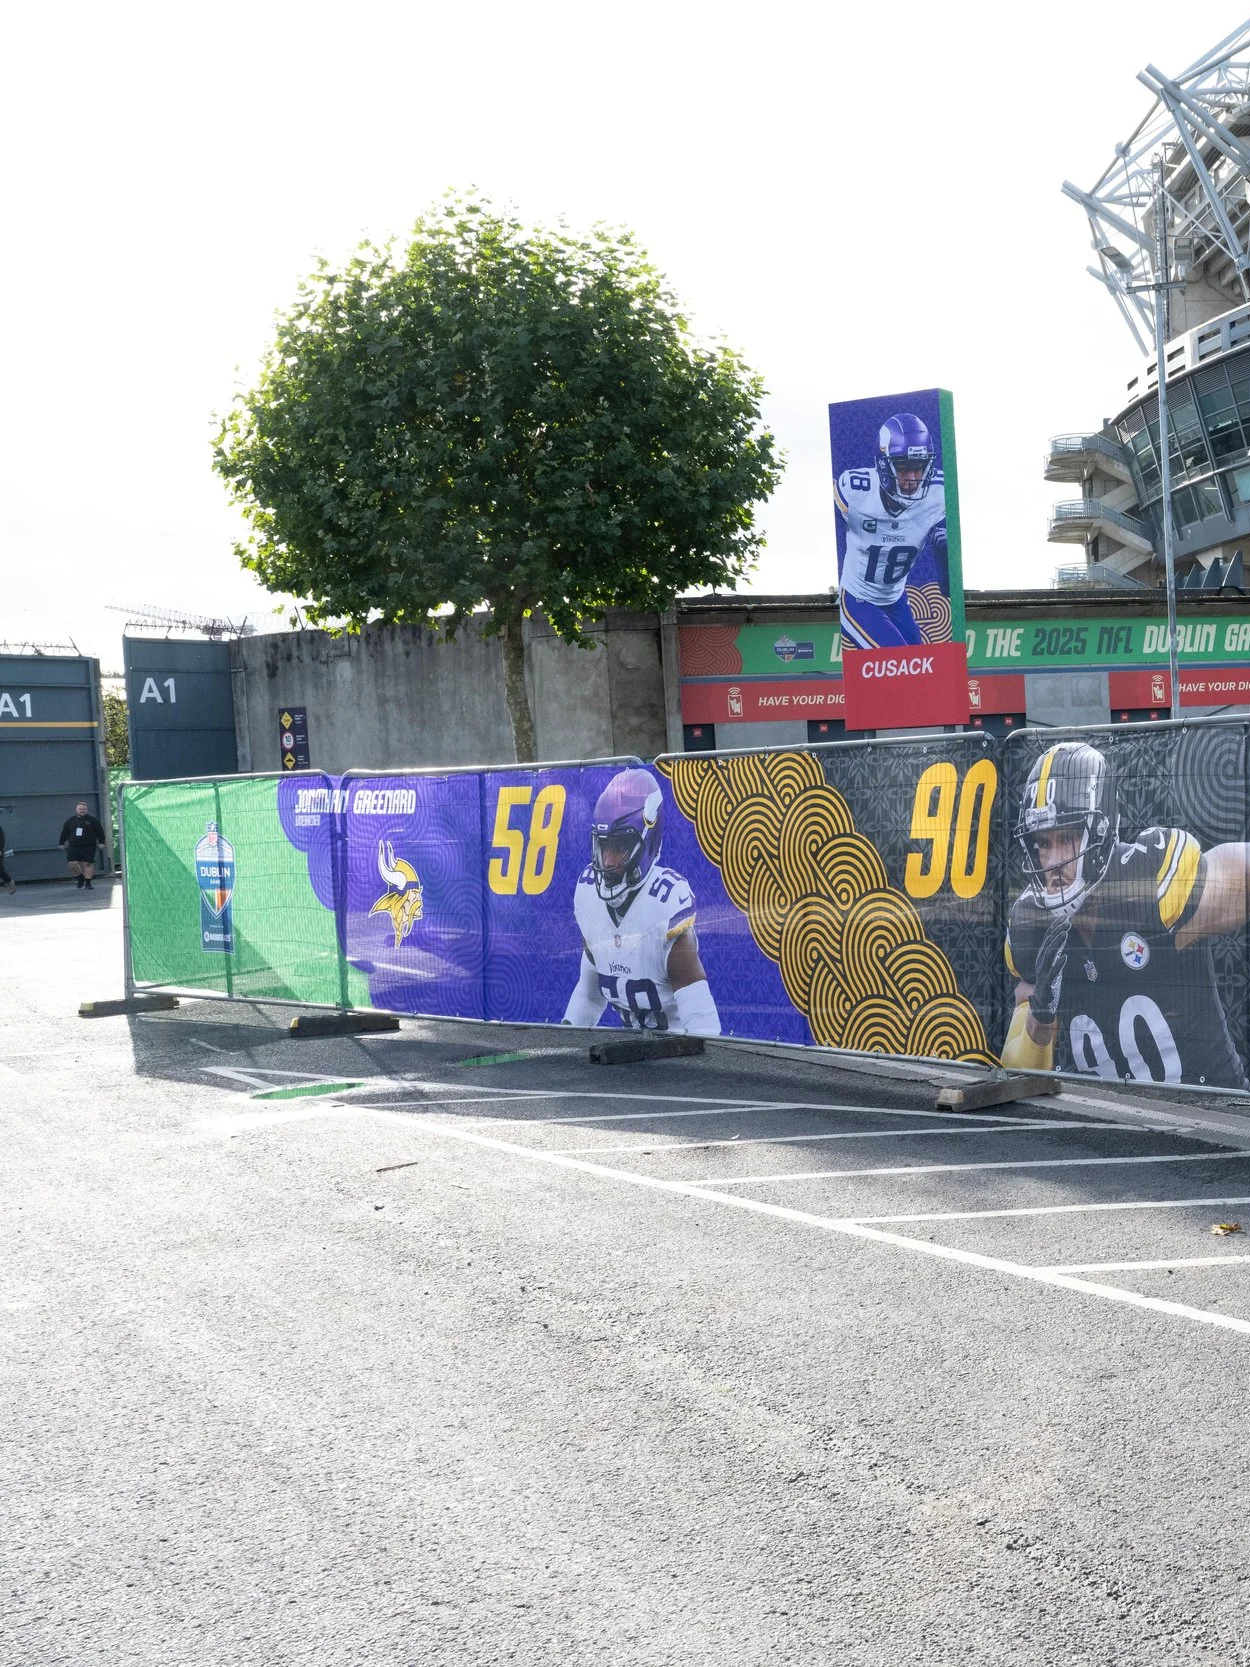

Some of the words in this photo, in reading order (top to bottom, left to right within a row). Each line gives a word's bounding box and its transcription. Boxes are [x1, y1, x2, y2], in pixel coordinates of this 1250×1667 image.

[864, 544, 919, 585] 18
[985, 628, 1024, 658] THE
[1031, 626, 1089, 656] 2025
[1096, 625, 1133, 654] NFL
[1143, 623, 1217, 654] DUBLIN
[861, 657, 935, 679] CUSACK
[139, 677, 177, 703] A1
[1178, 683, 1206, 692] HAVE
[1207, 682, 1236, 691] YOUR
[0, 693, 32, 718] A1
[758, 696, 790, 707] HAVE
[792, 694, 824, 705] YOUR
[295, 788, 349, 813] JONATHAN
[353, 789, 417, 814] GREENARD
[488, 784, 567, 895] 58
[904, 758, 998, 899] 90
[200, 866, 231, 878] DUBLIN
